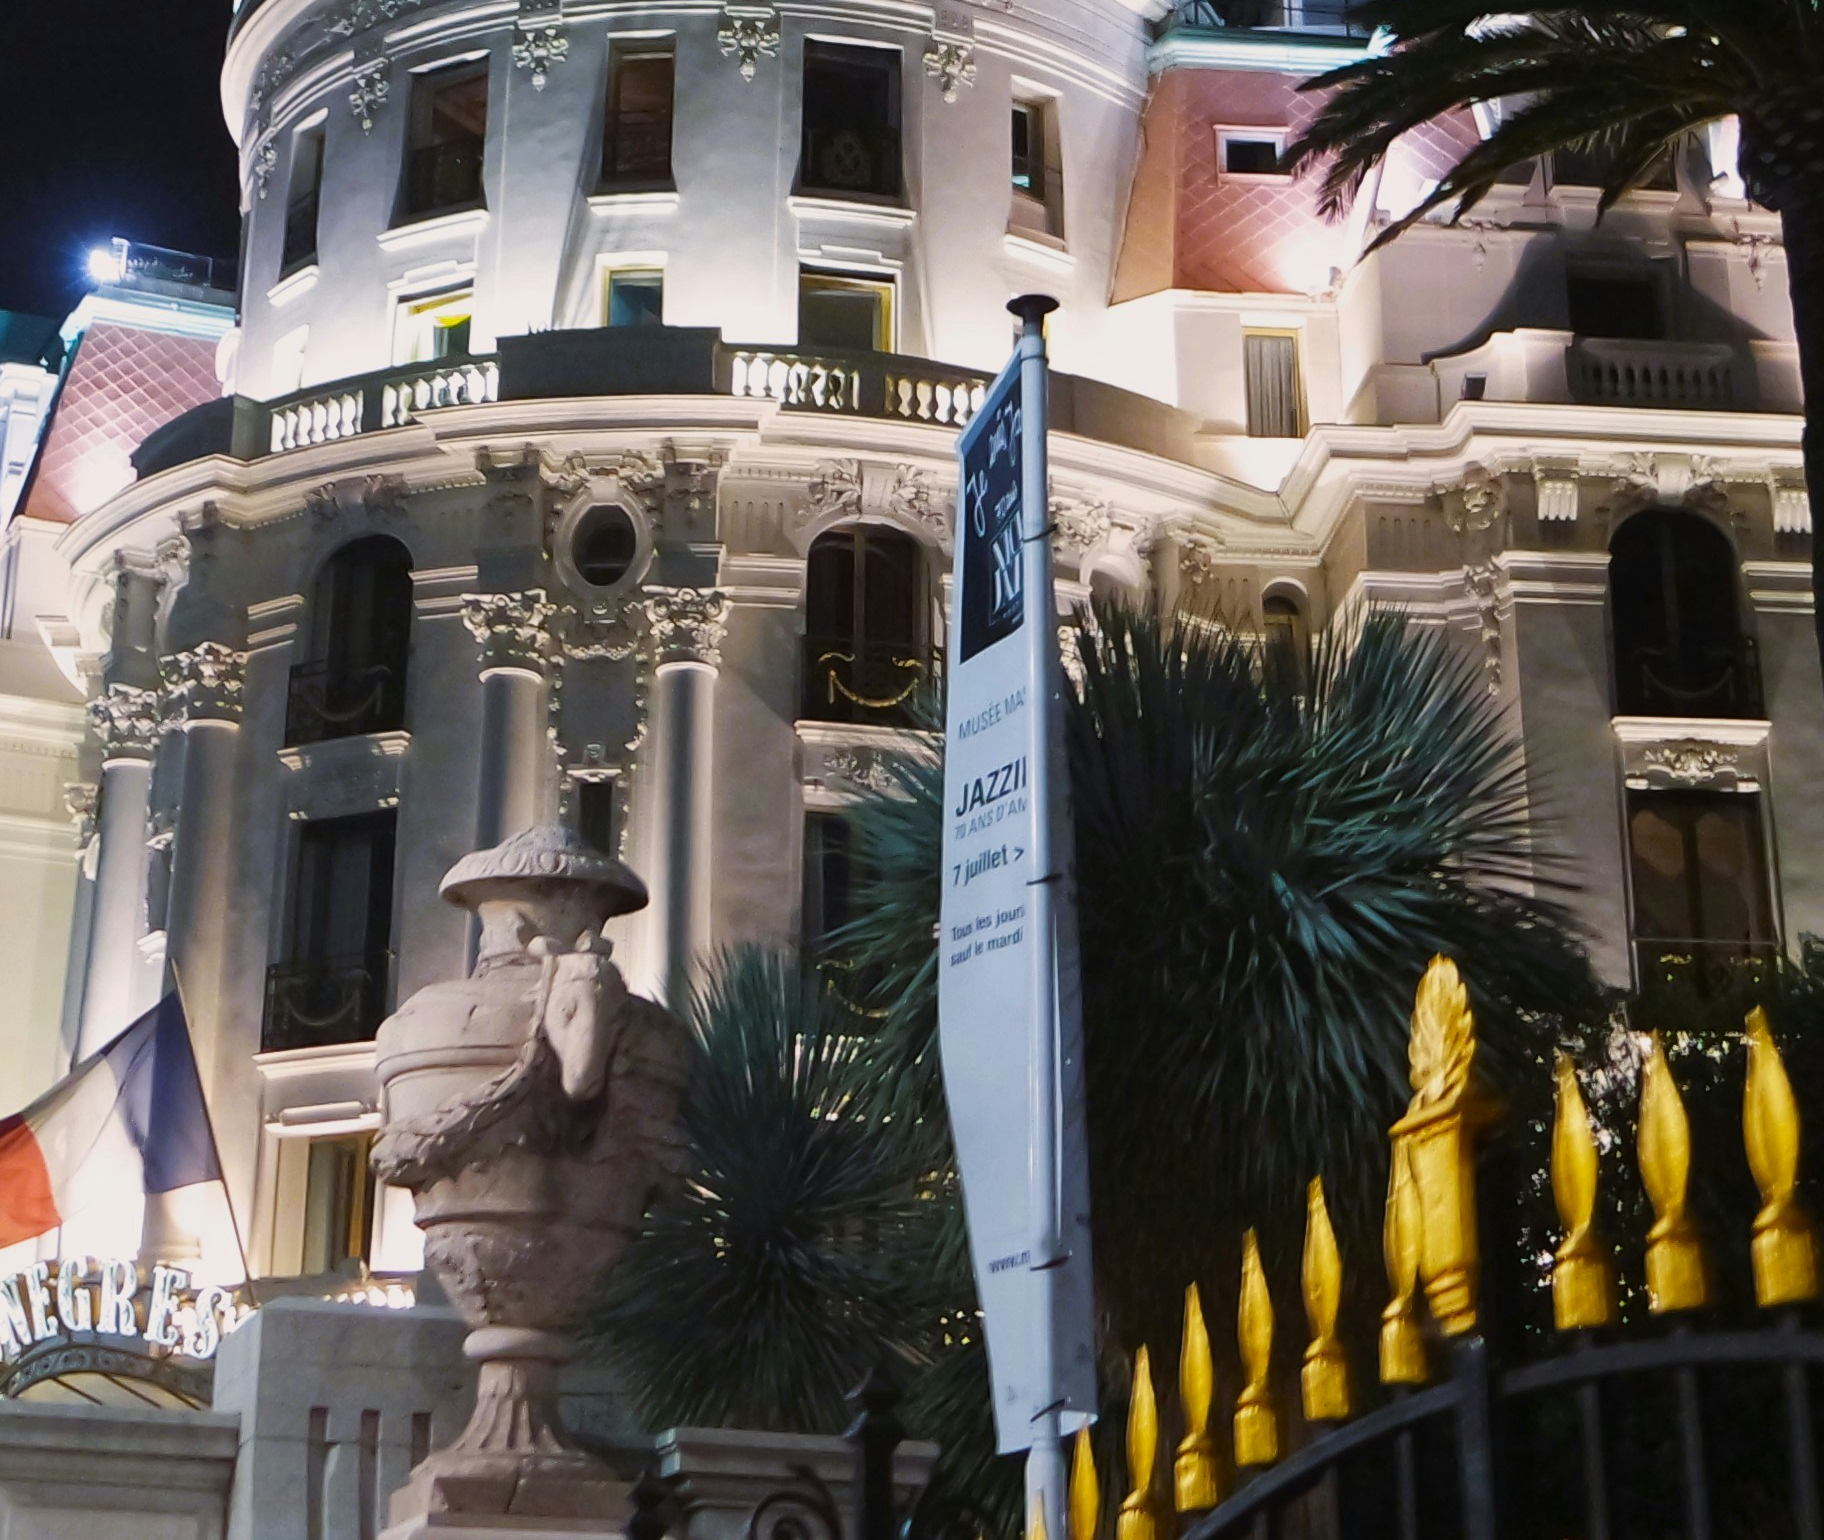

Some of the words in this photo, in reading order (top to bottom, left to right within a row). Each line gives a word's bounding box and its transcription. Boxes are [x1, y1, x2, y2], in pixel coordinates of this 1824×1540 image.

[958, 700, 1002, 741] MUSÉE
[953, 863, 962, 886] 7
[963, 843, 1008, 887] juillet
